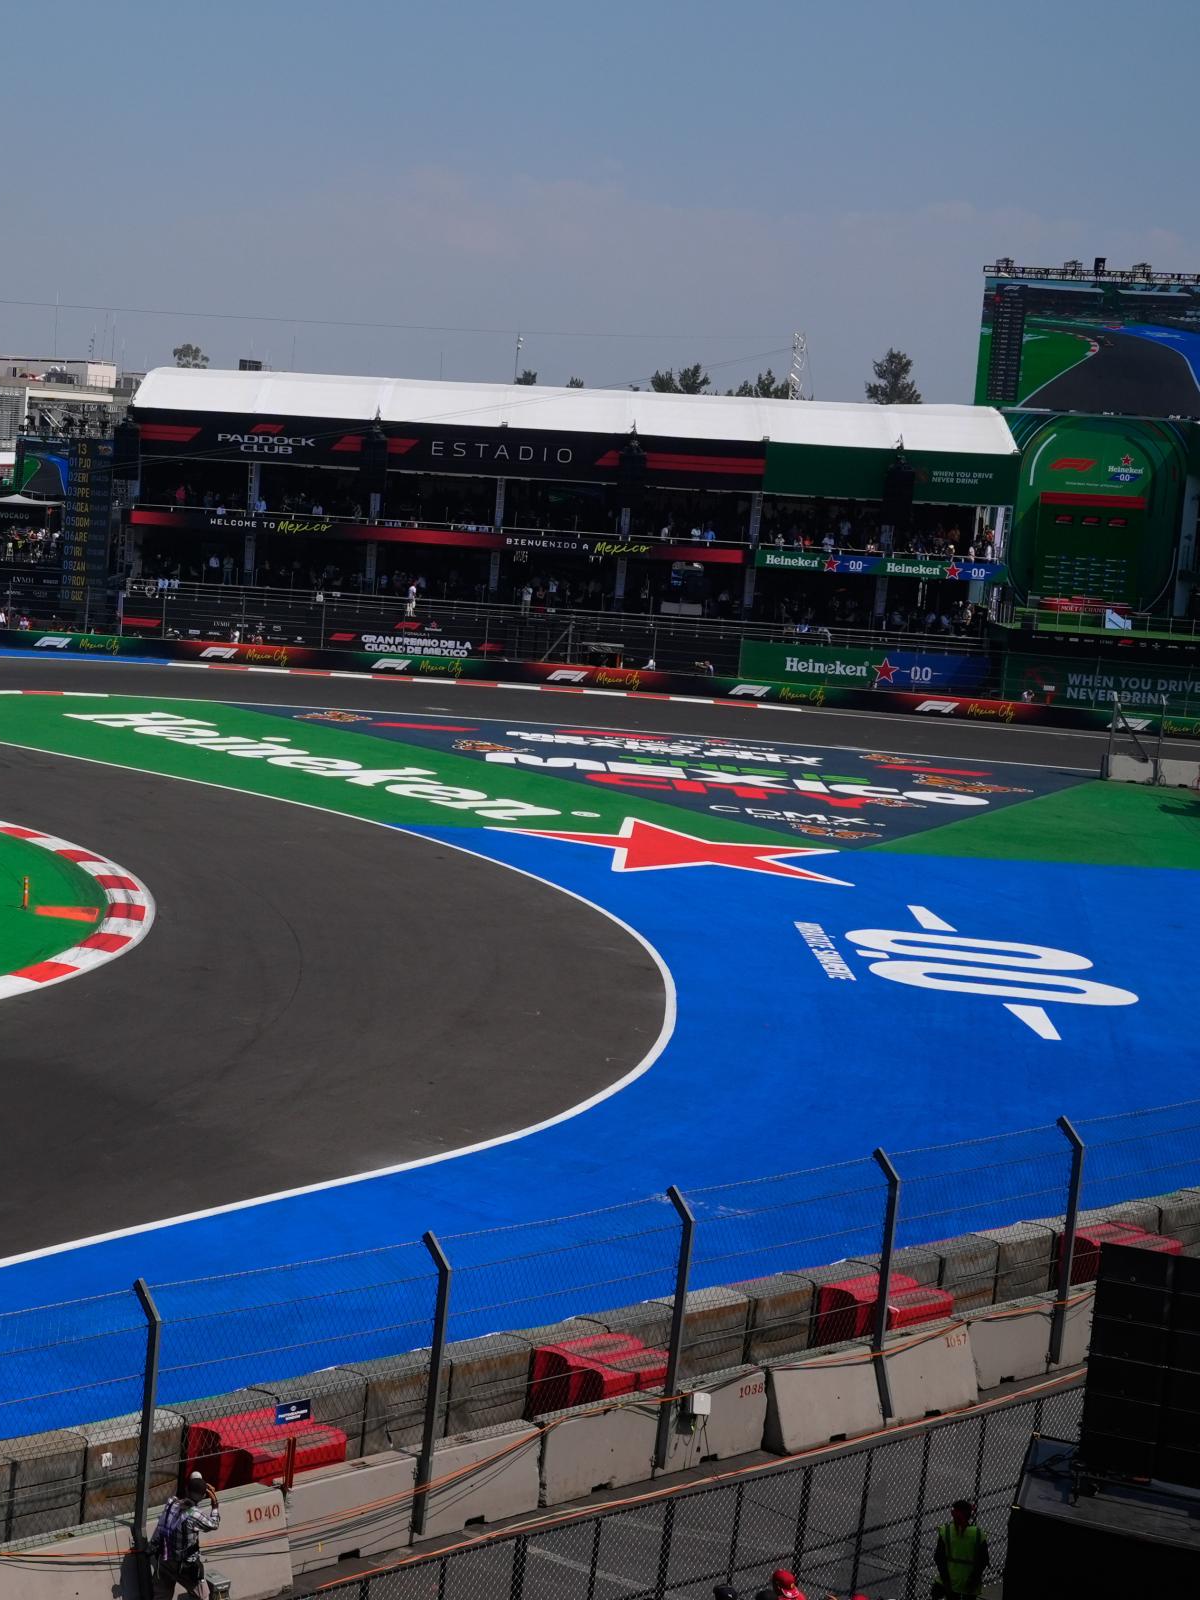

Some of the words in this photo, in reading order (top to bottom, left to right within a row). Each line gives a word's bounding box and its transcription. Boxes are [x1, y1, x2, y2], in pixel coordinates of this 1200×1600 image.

[217, 433, 316, 447] PADDOCK
[240, 445, 293, 455] CLUB
[431, 441, 573, 463] ESTADIO
[1107, 465, 1145, 474] Heineken
[77, 488, 90, 498] PPE
[210, 518, 257, 528] WELCOME
[263, 521, 275, 529] TO
[277, 520, 332, 534] Mexico
[74, 532, 88, 543] ARE
[506, 537, 577, 550] BIENVENIDO
[594, 541, 651, 554] Mexico
[73, 561, 85, 571] ZAN
[765, 554, 818, 568] Heineken
[887, 562, 940, 575] Heineken
[361, 635, 394, 644] GRAN
[395, 636, 439, 648] PREMIO
[441, 640, 455, 649] DE
[456, 640, 472, 650] LA
[364, 643, 405, 653] CIUDAD
[407, 645, 422, 654] DE
[785, 657, 867, 677] Heineken
[1068, 673, 1114, 687] WHEN
[1119, 676, 1151, 690] YOU
[1157, 679, 1200, 694] DRIVE
[1066, 687, 1115, 702] NEVER
[1118, 691, 1170, 705] DRINK
[62, 711, 563, 821] Heineken
[618, 755, 789, 778] THIS
[801, 773, 873, 785] IS
[485, 752, 990, 805] MEXICO
[584, 773, 874, 809] CITY
[709, 805, 871, 825] CDMX
[753, 815, 812, 823] MEXICO
[246, 1504, 281, 1524] 1040
